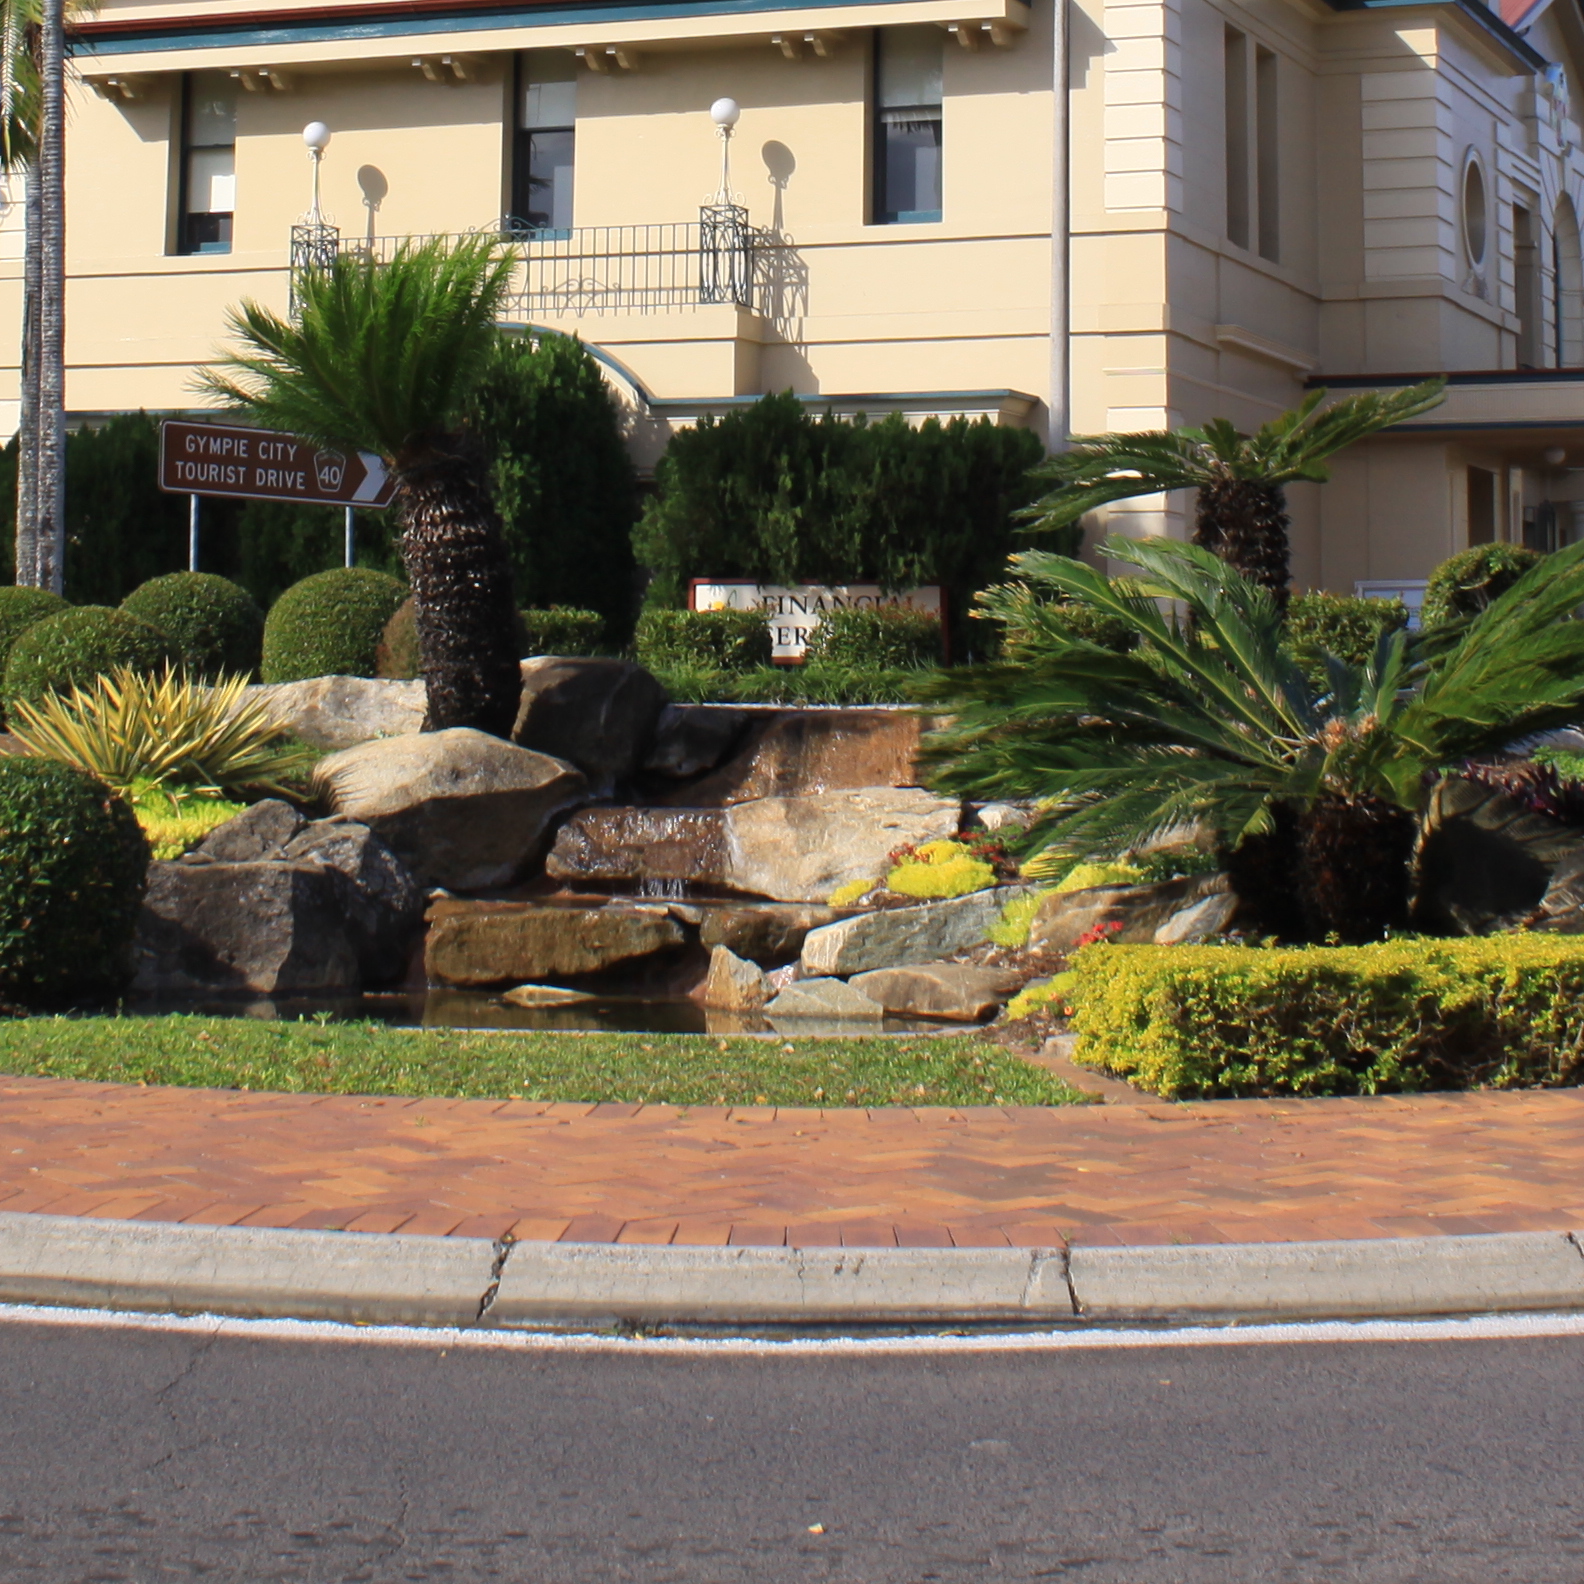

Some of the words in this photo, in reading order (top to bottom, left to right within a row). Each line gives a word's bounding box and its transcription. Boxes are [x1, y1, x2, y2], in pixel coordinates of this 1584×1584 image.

[185, 434, 249, 458] GYMPIE
[258, 440, 298, 462] CITY
[175, 460, 247, 485] TOURIST
[255, 467, 306, 490] DRIVE
[319, 466, 341, 485] 40
